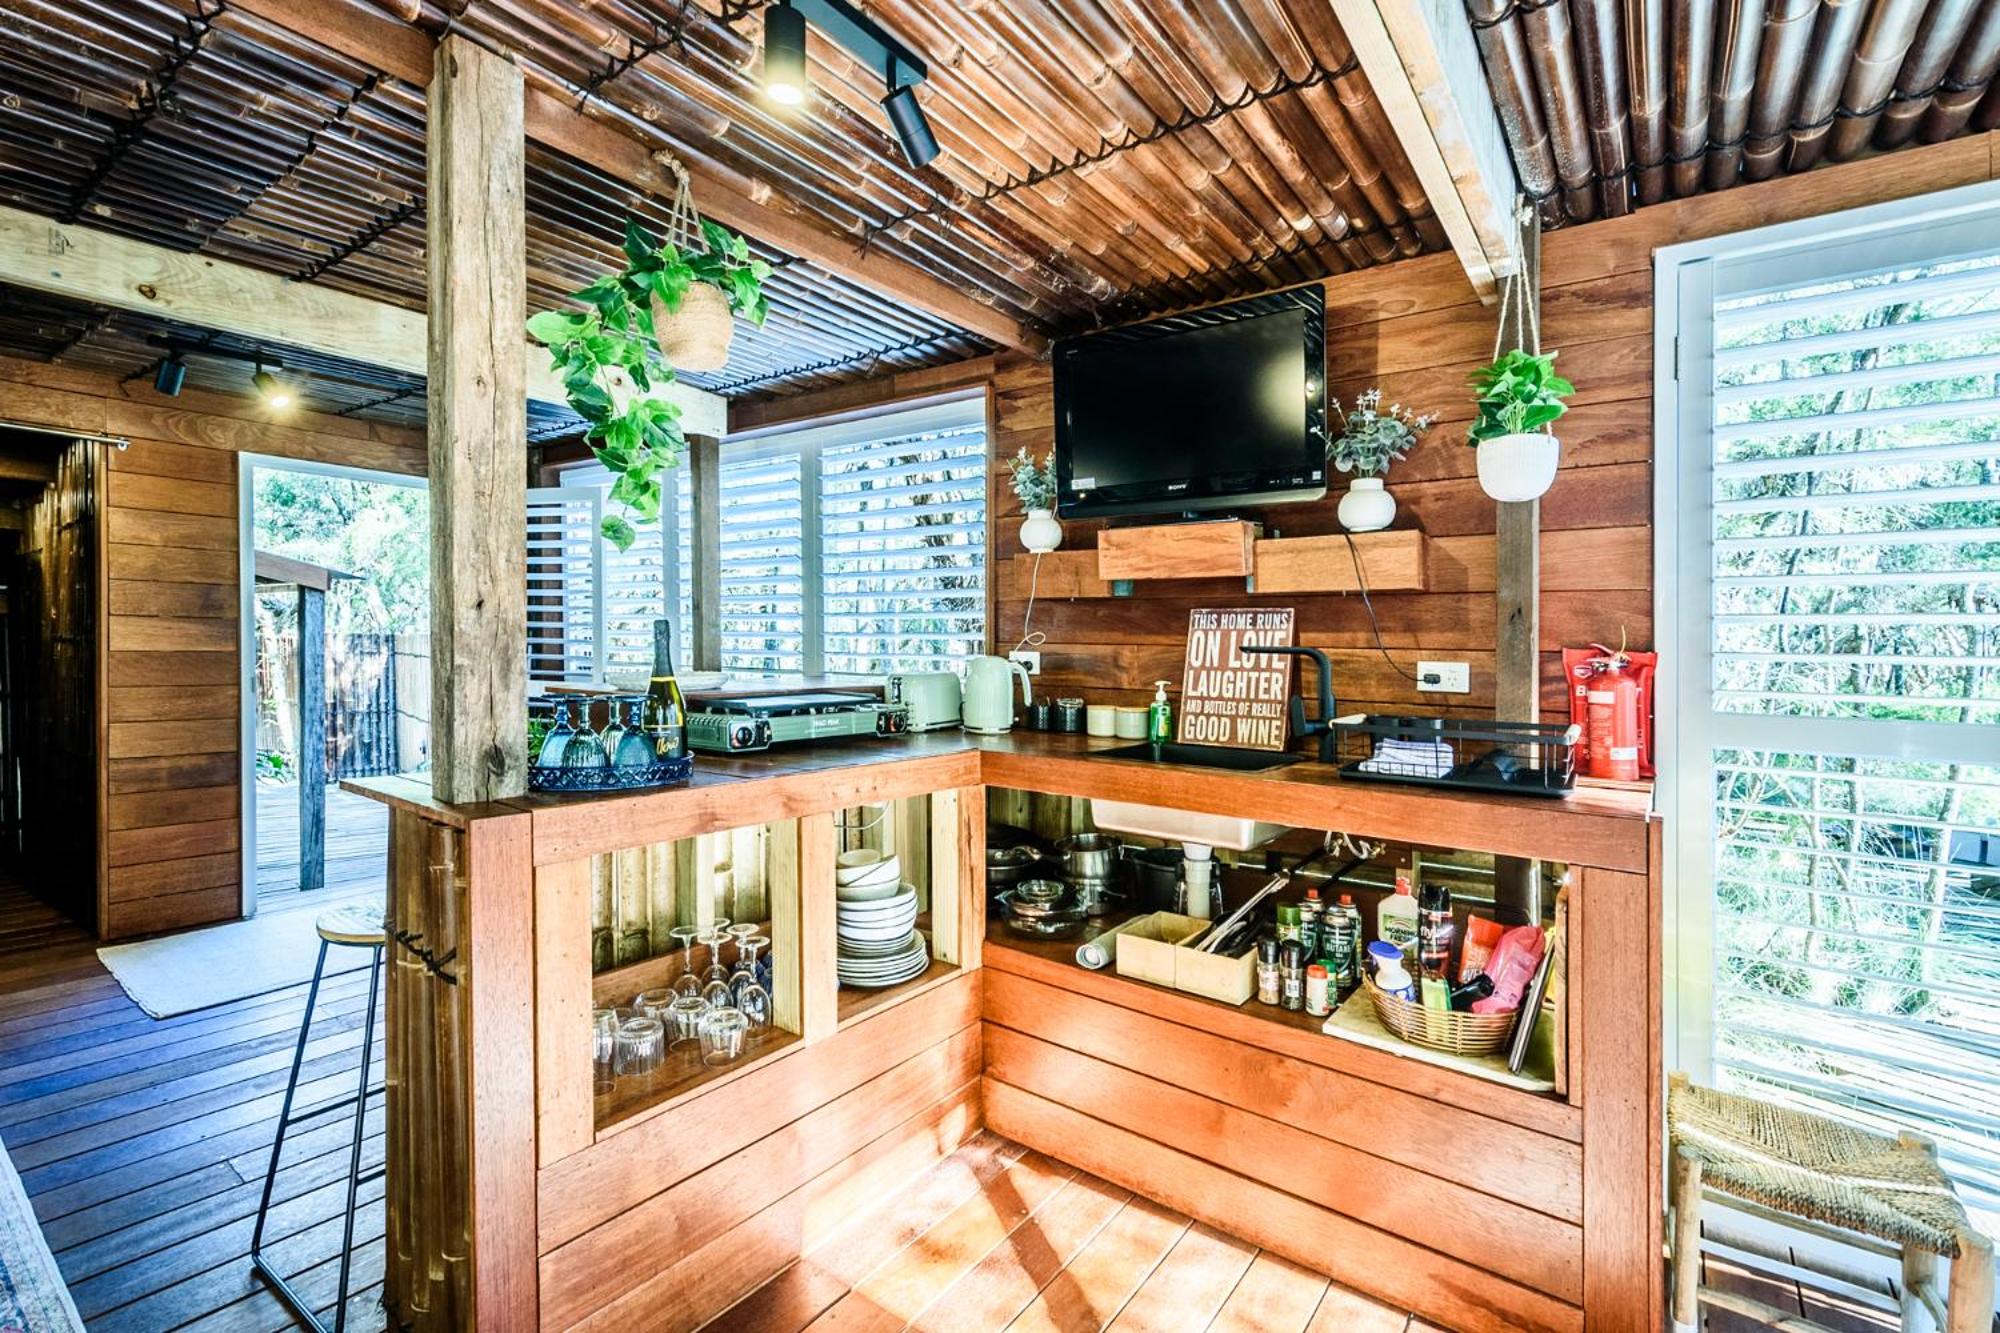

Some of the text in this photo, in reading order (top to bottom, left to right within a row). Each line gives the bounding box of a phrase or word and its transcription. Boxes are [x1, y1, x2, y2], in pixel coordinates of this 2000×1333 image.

[1194, 613, 1288, 630] THIS HOME RUNS
[1190, 630, 1286, 669] ON LOVE
[1187, 670, 1283, 700] LAUGHTER
[1186, 700, 1282, 718] AND BOTTLES OF REALLY
[1184, 715, 1282, 745] GOOD WINE
